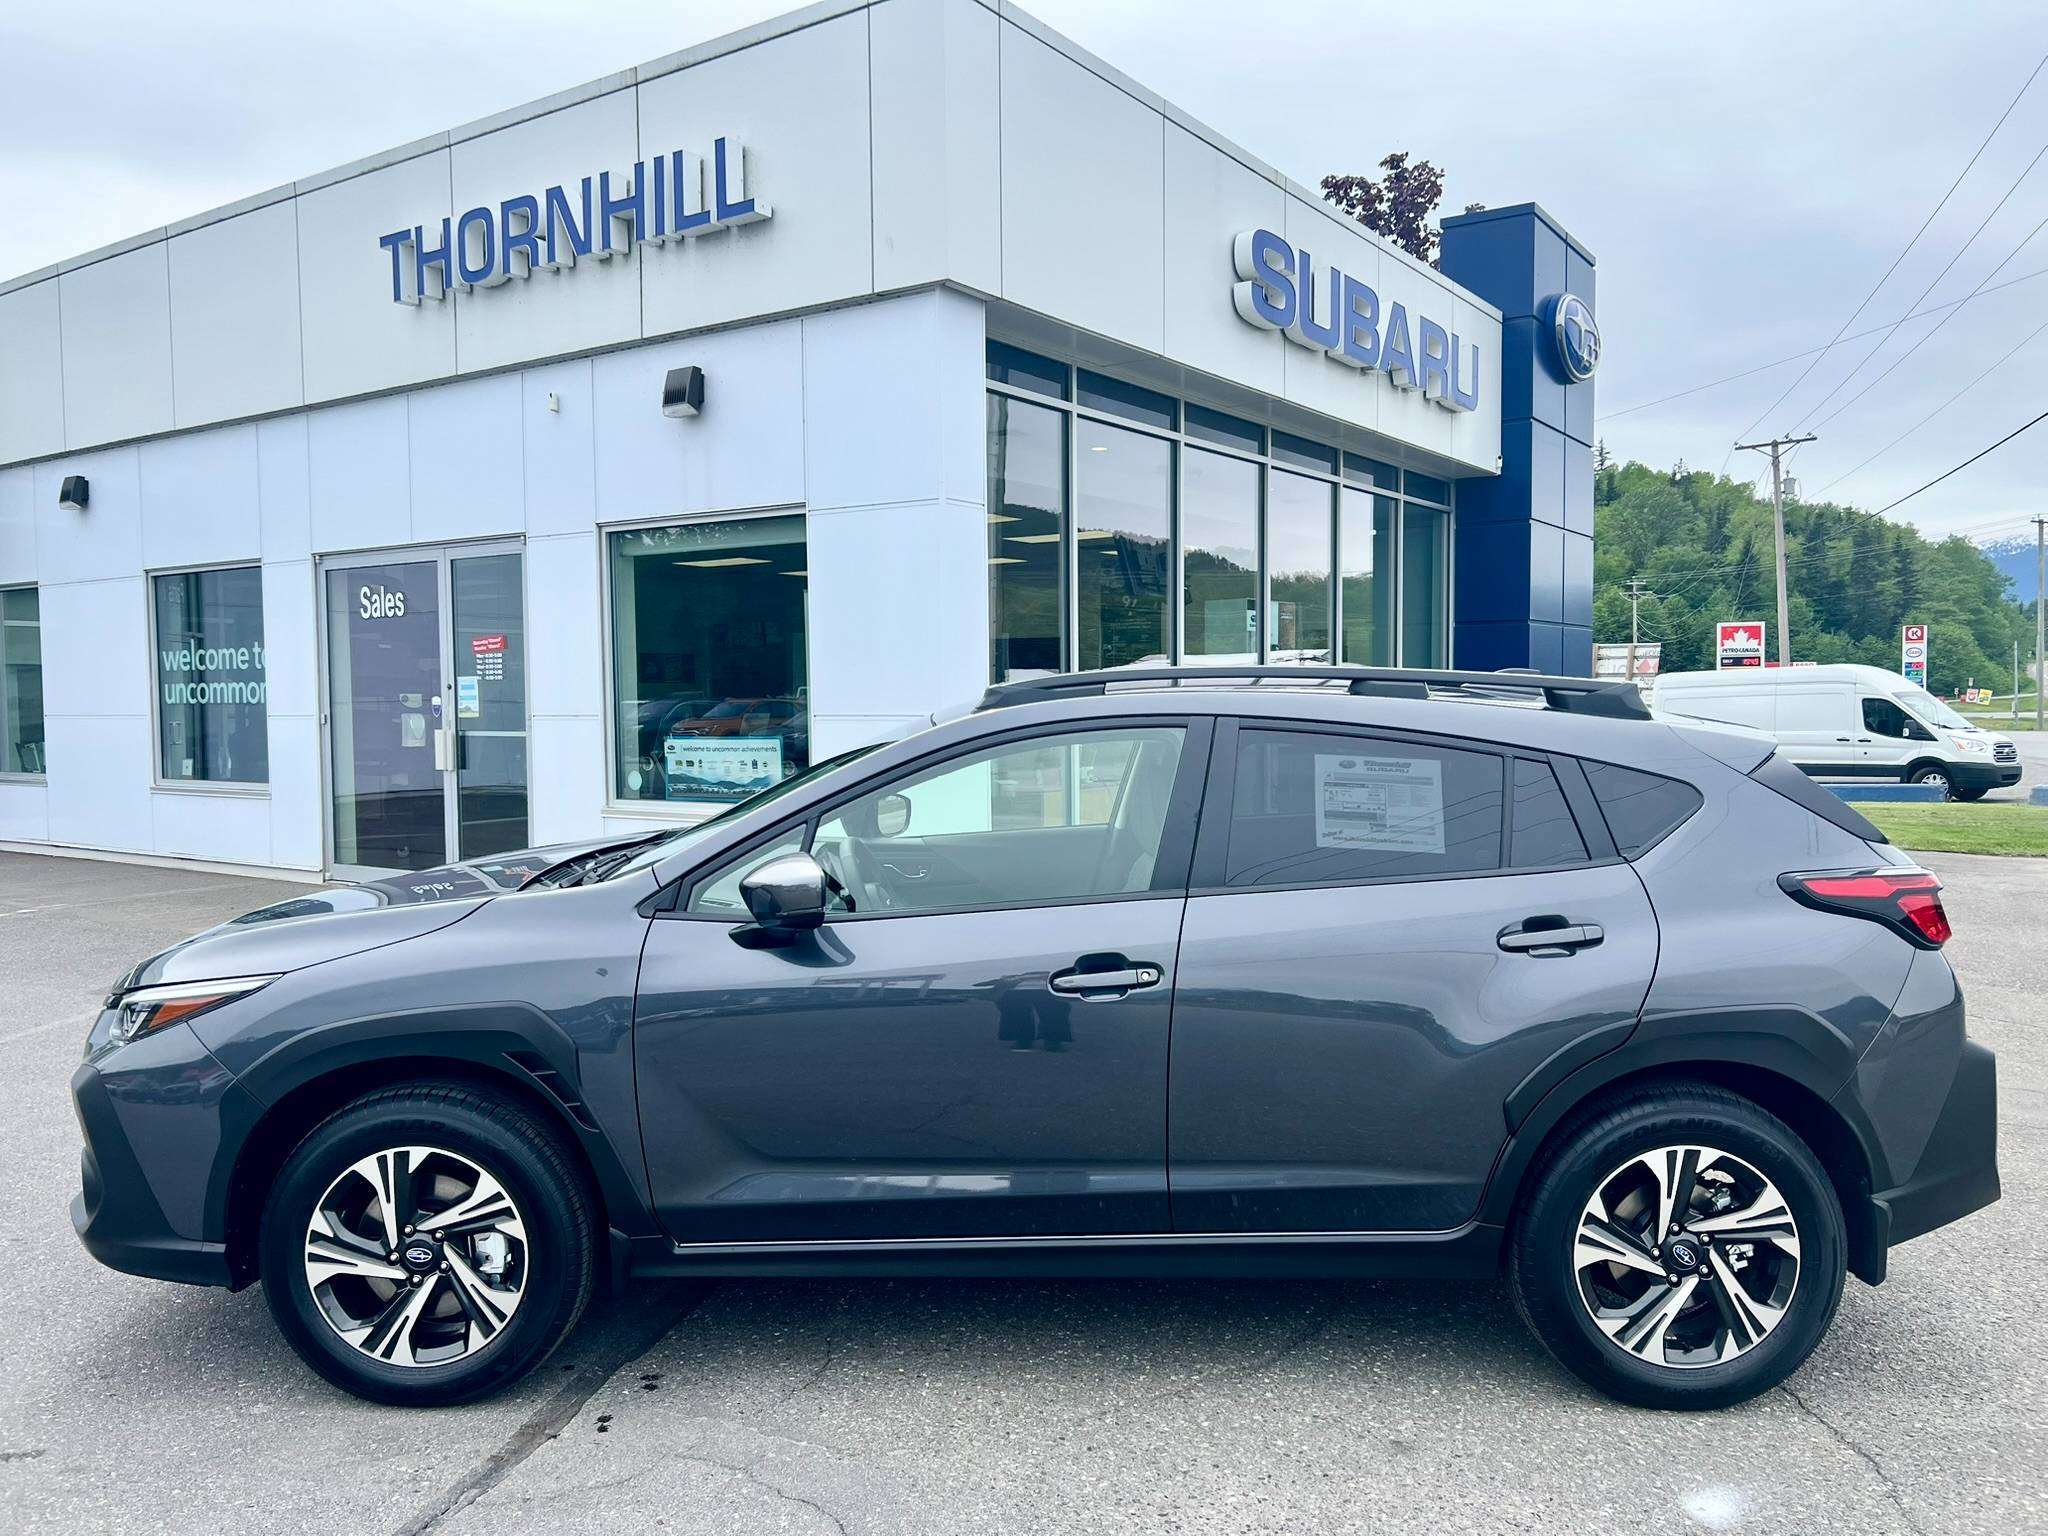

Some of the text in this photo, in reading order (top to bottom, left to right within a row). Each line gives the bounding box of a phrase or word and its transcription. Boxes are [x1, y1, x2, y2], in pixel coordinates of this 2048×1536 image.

[379, 137, 757, 304] THORNHILL
[1246, 228, 1480, 412] SUBARU
[360, 585, 405, 620] Sales
[162, 638, 250, 672] welcome
[164, 680, 267, 705] uncommon
